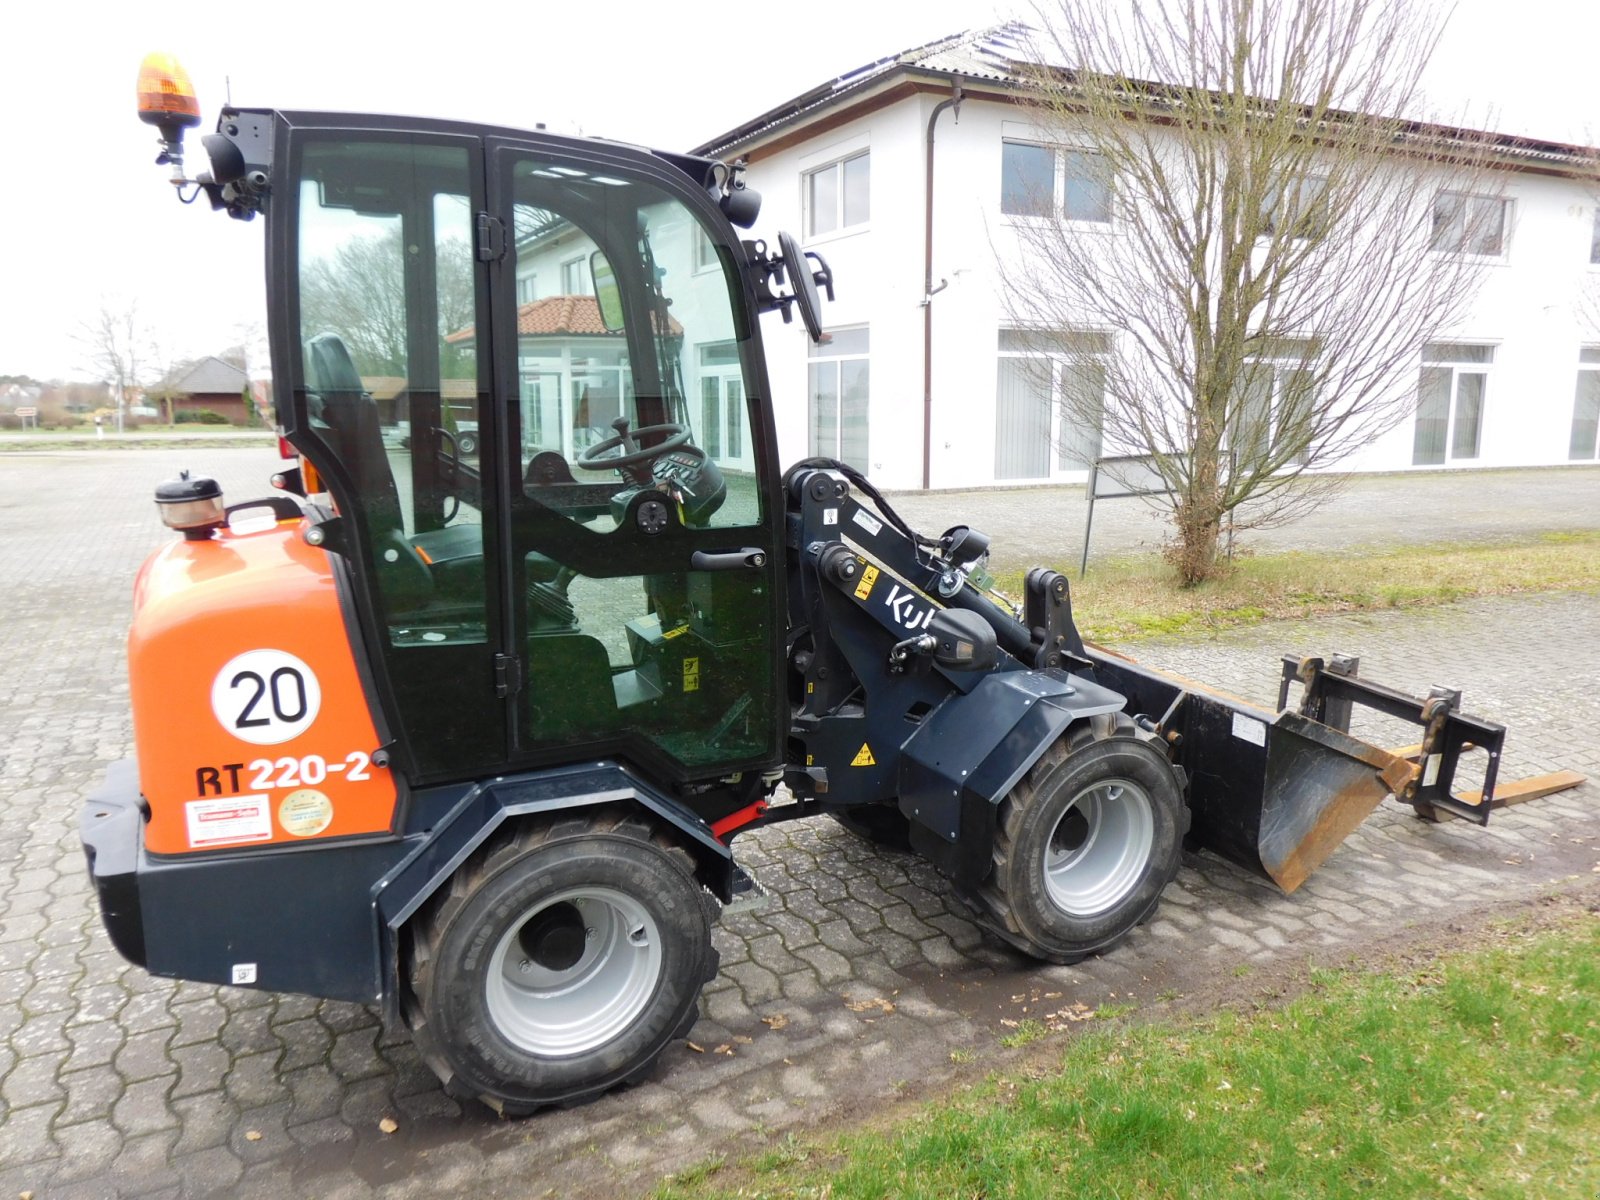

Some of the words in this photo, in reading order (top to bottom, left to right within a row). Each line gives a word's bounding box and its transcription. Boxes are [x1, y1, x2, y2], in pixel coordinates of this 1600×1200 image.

[230, 666, 308, 729] 20
[464, 924, 494, 971] SKID
[495, 874, 554, 919] STEER
